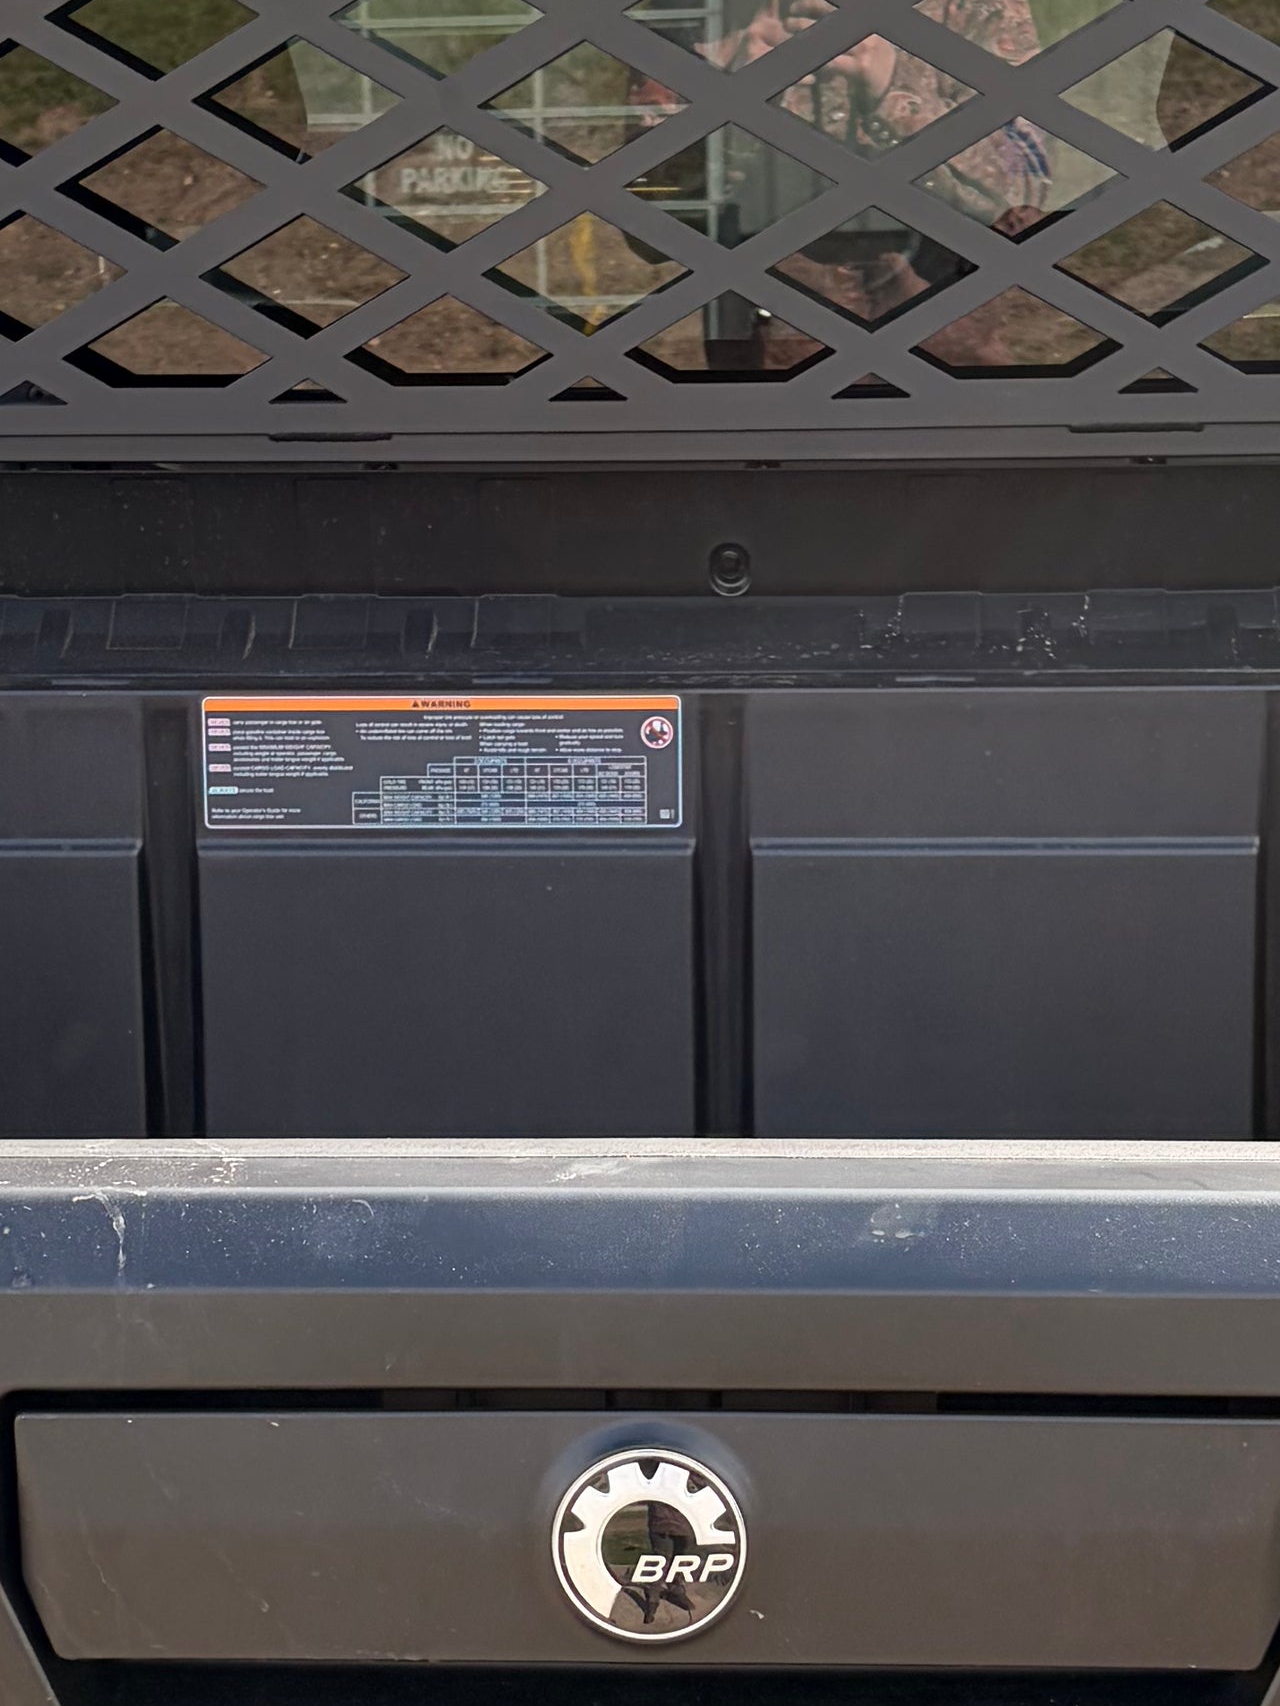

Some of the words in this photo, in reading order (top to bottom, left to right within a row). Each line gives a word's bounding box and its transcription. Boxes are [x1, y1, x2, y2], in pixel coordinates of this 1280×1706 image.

[400, 166, 510, 193] PARKING
[421, 701, 471, 709] WARNING
[629, 1552, 735, 1585] BRP
